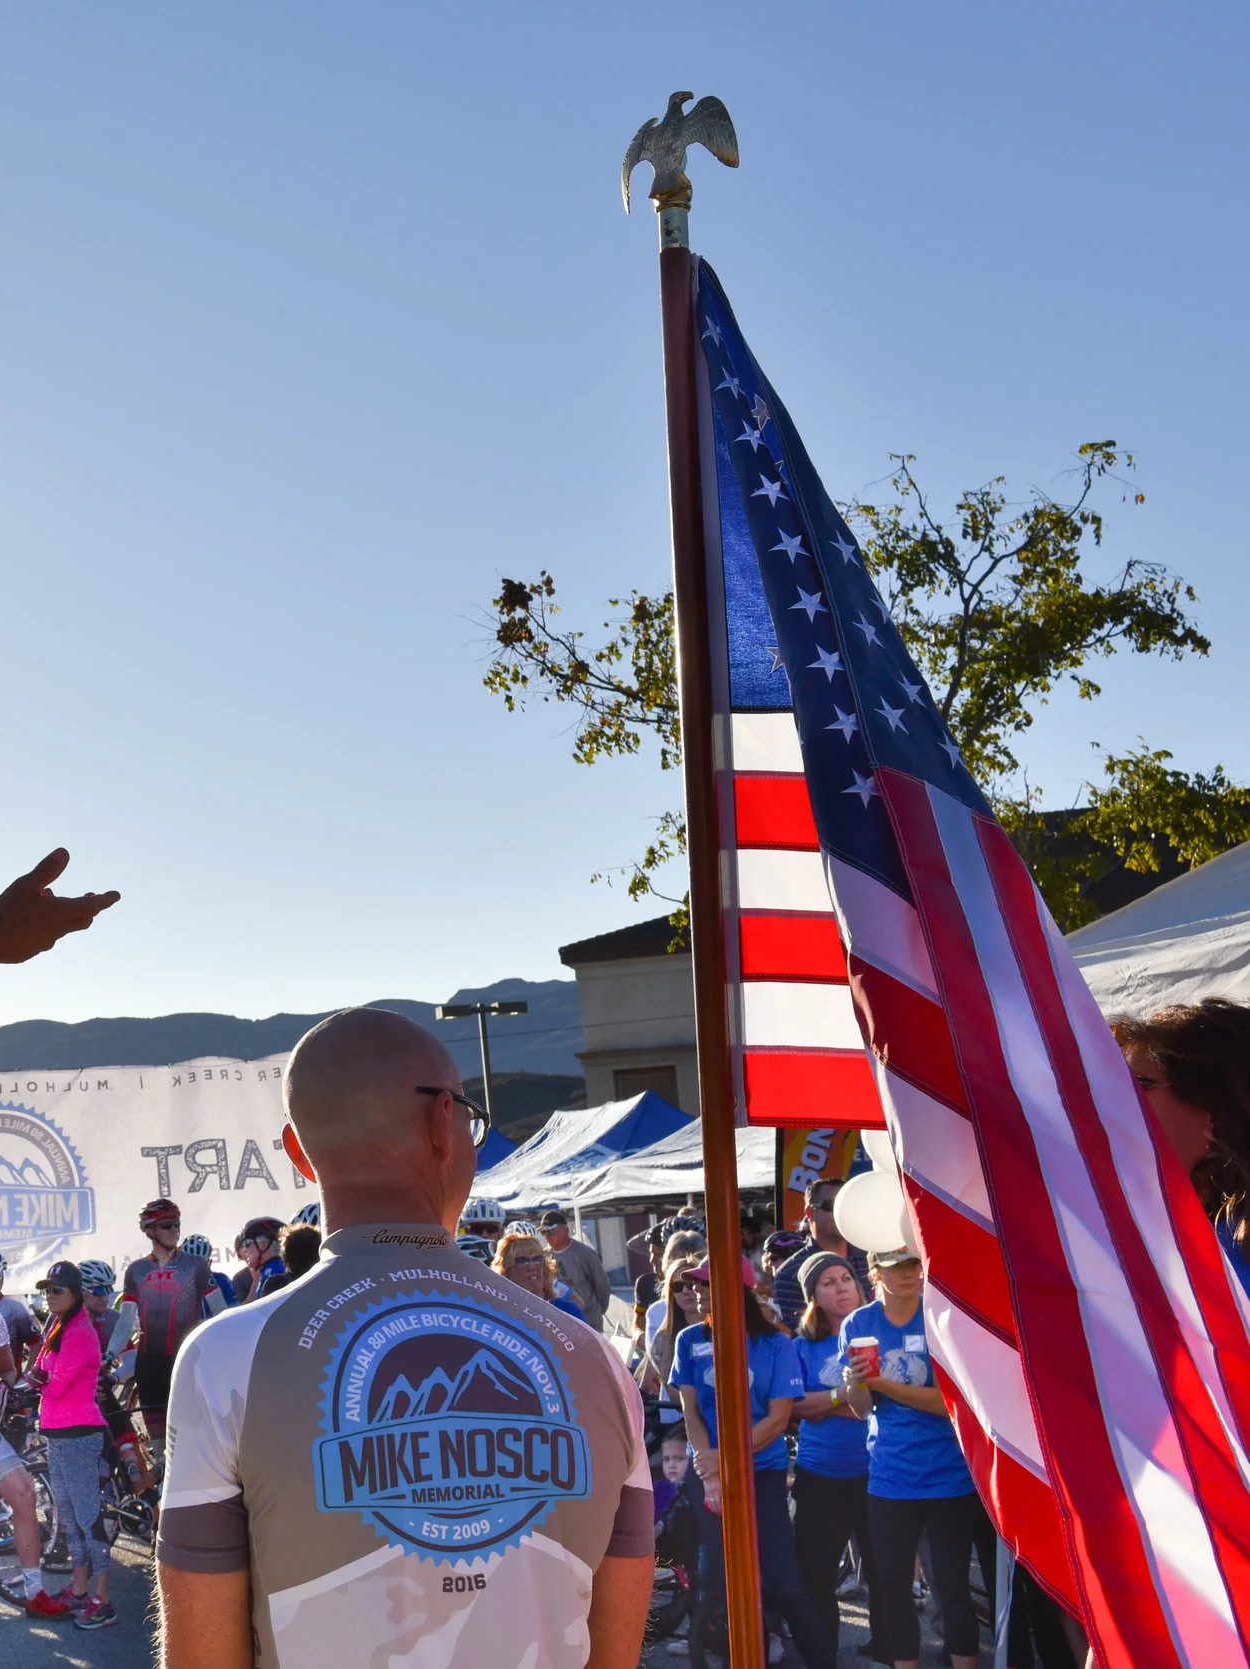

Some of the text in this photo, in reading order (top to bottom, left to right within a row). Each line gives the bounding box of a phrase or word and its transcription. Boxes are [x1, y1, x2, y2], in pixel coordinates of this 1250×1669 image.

[787, 1128, 836, 1194] BON
[298, 1268, 576, 1352] DEER CREEK MULHOLLAND LATIGO
[345, 1348, 376, 1422] ANNUAL
[367, 1331, 387, 1350] 80
[382, 1315, 421, 1339] MILE
[420, 1313, 492, 1337] BICYCLE
[491, 1329, 531, 1360] RIDE
[338, 1427, 576, 1504] MIKE NOSCO
[411, 1483, 506, 1504] MEMORIAL
[421, 1518, 492, 1540] EST 2009
[442, 1573, 487, 1594] 2016
